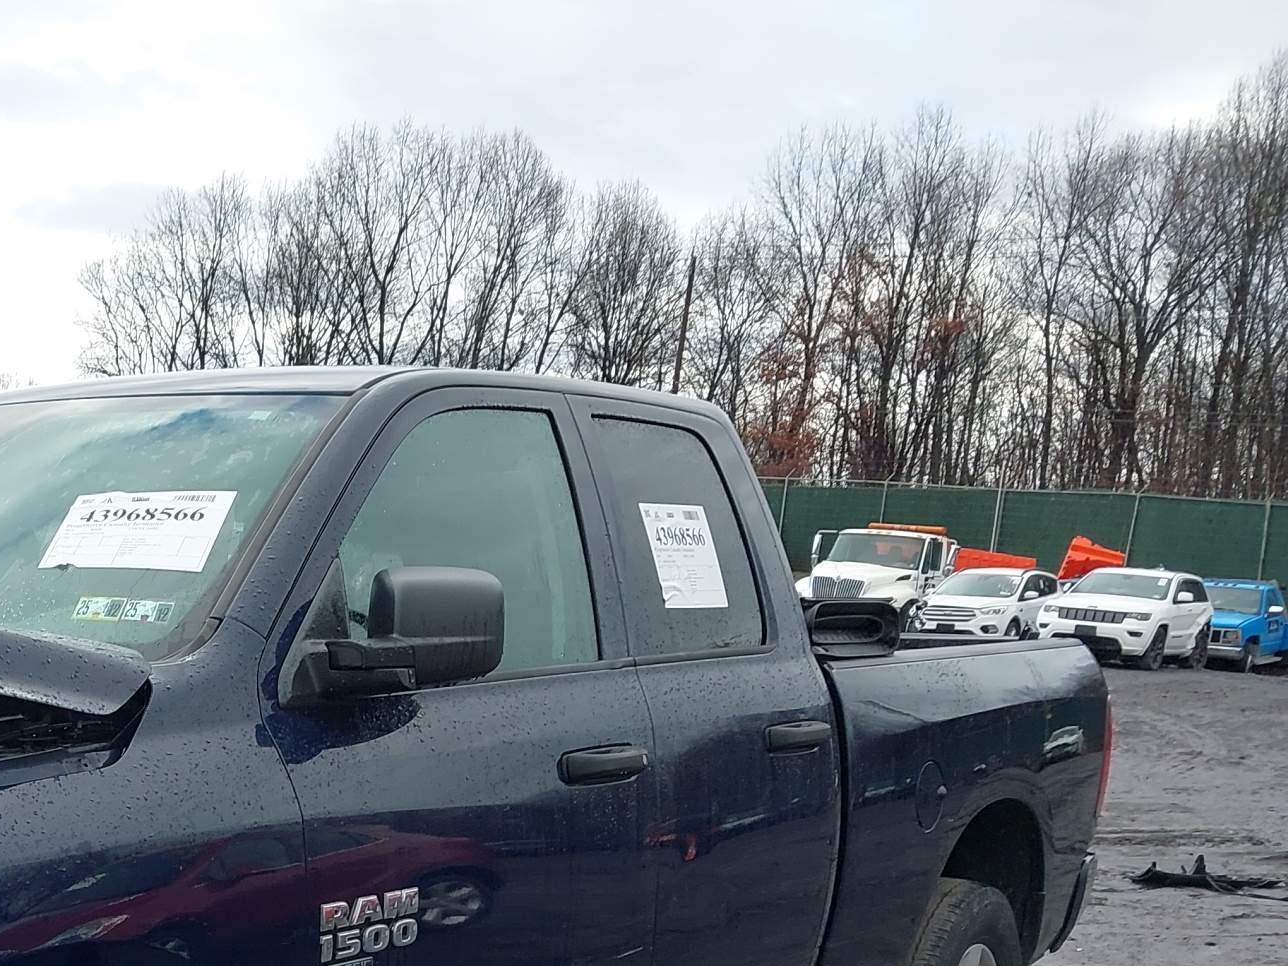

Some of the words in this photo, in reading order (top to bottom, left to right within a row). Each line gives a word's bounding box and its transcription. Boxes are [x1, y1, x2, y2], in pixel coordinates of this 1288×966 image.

[80, 506, 208, 522] 43968566
[655, 526, 705, 545] 43968566
[76, 600, 92, 615] 25
[124, 601, 140, 617] 25
[320, 887, 419, 931] RAM
[320, 918, 418, 963] 1500
